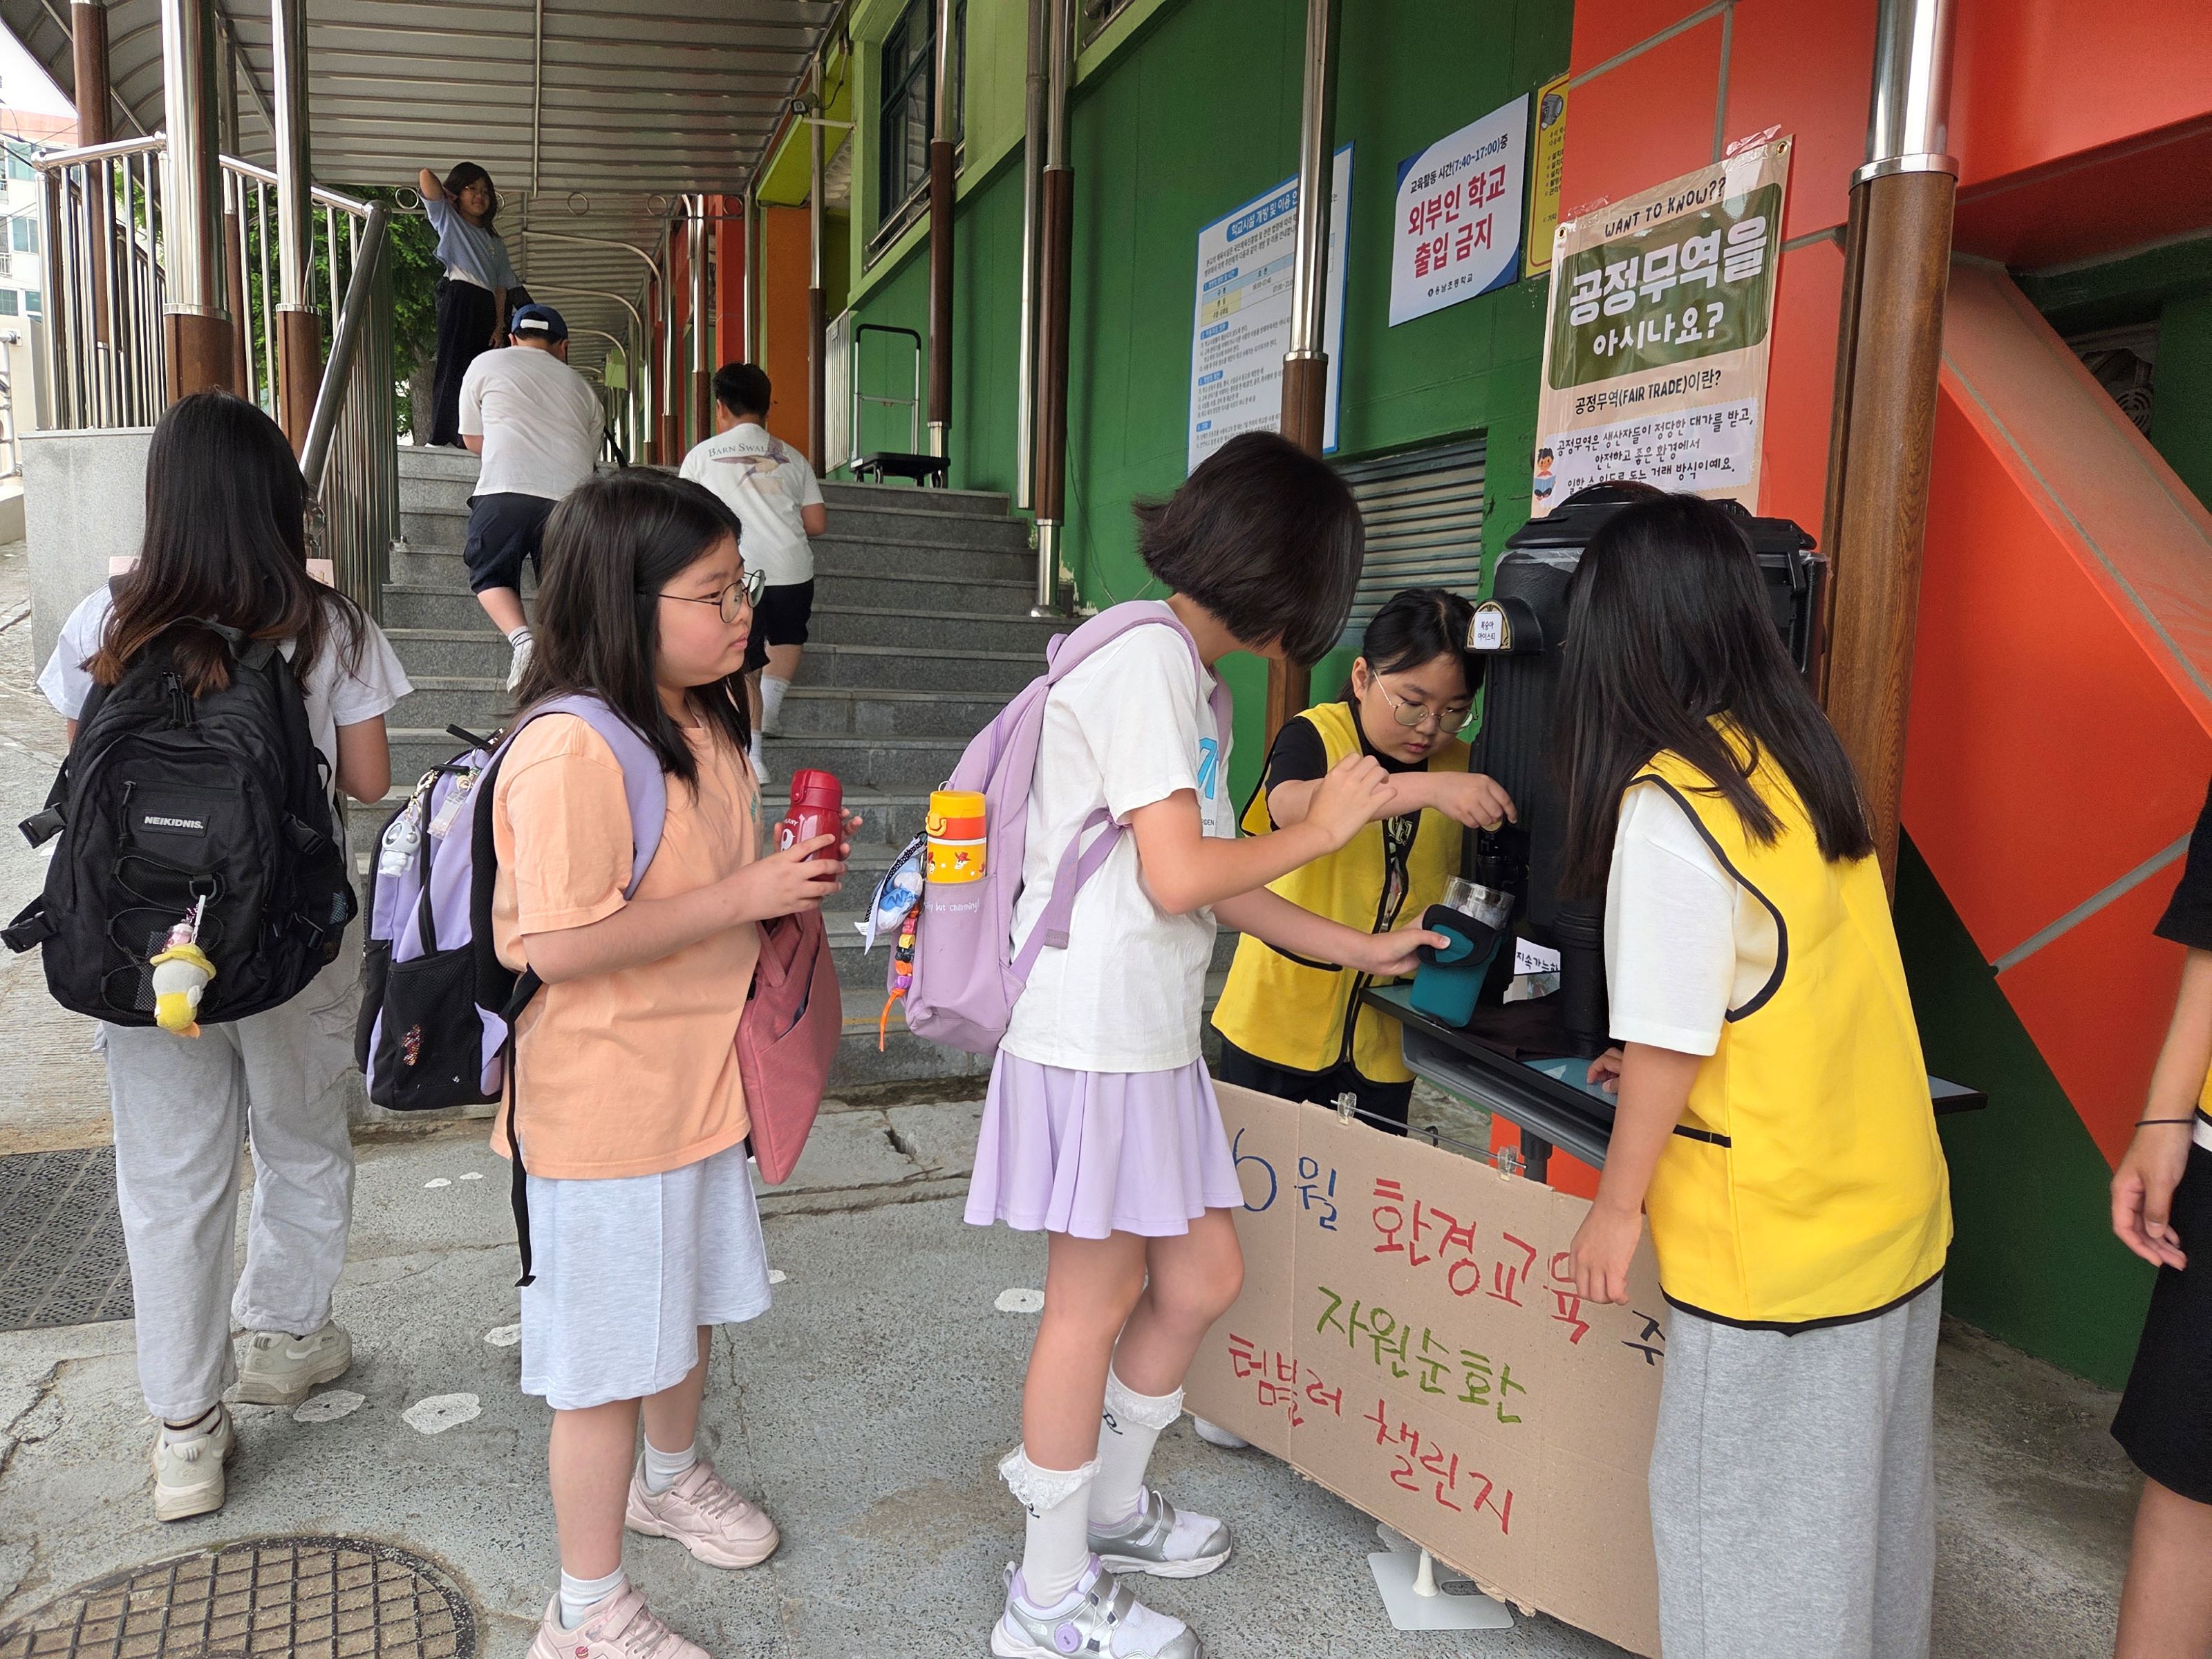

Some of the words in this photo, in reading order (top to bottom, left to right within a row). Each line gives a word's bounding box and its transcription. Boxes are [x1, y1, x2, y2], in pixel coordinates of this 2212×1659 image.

[1407, 183, 1461, 236] 외부인
[1468, 164, 1506, 209] 학교
[1410, 169, 1437, 194] 교육활동
[1549, 185, 1561, 196] 관리
[1231, 214, 1255, 236] 학교시설
[1256, 207, 1269, 223] 개방
[1270, 202, 1277, 217] 및
[1277, 194, 1291, 211] 이용
[1605, 212, 1640, 238] WANT
[1646, 203, 1662, 222] TO
[1667, 176, 1727, 214] KNOW??
[1414, 232, 1449, 279] 출입
[1455, 212, 1493, 261] 금지
[1569, 216, 1767, 326] 공정무역을
[1593, 301, 1724, 357] 아시나요?
[1575, 385, 1645, 415] 공정무역(FAIR
[1648, 369, 1722, 399] TRADE)이란?
[709, 445, 736, 457] BARN
[1557, 434, 1600, 457] 공정무역은
[1603, 424, 1651, 449] 생산자들이
[1654, 418, 1687, 440] 정당한
[1689, 412, 1723, 433] 대가를
[1727, 407, 1754, 429] 받고,
[1595, 449, 1631, 471] 안전하고
[1634, 446, 1653, 465] 좋은
[1656, 438, 1700, 462] 환경에서
[1651, 464, 1672, 478] 거래
[1676, 457, 1735, 481] 방식이예요.
[1477, 632, 1496, 642] 아이스티
[1481, 620, 1494, 630] 복숭아
[144, 816, 205, 830] NEIKIDNIS.
[935, 901, 946, 912] but
[1371, 1177, 1590, 1344] 환경교육
[1315, 1284, 1527, 1424] 자원순환
[1228, 1333, 1342, 1427] 텀블러
[1363, 1398, 1513, 1535] 챌린지
